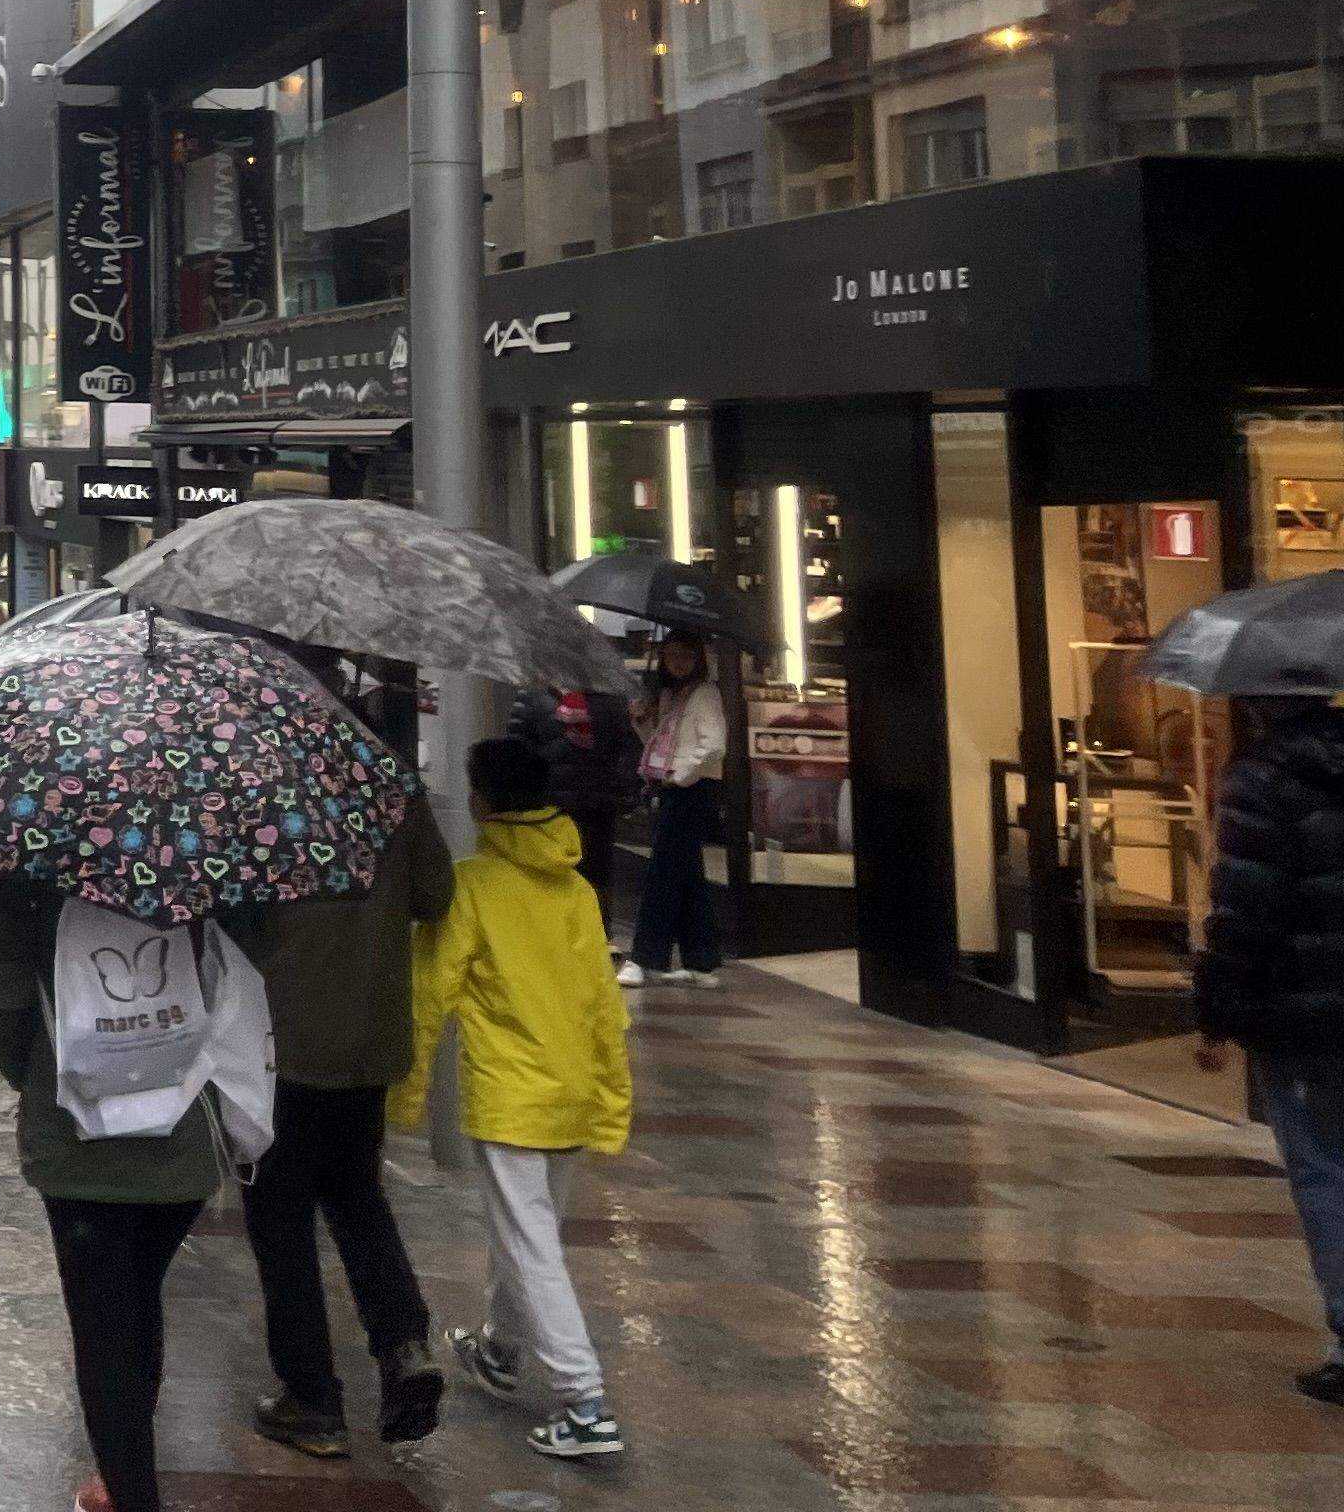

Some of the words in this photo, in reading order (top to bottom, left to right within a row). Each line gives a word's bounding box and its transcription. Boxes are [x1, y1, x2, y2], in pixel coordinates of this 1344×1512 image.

[69, 131, 144, 345] L'informal
[83, 482, 151, 500] KRACK
[95, 1013, 150, 1032] marc
